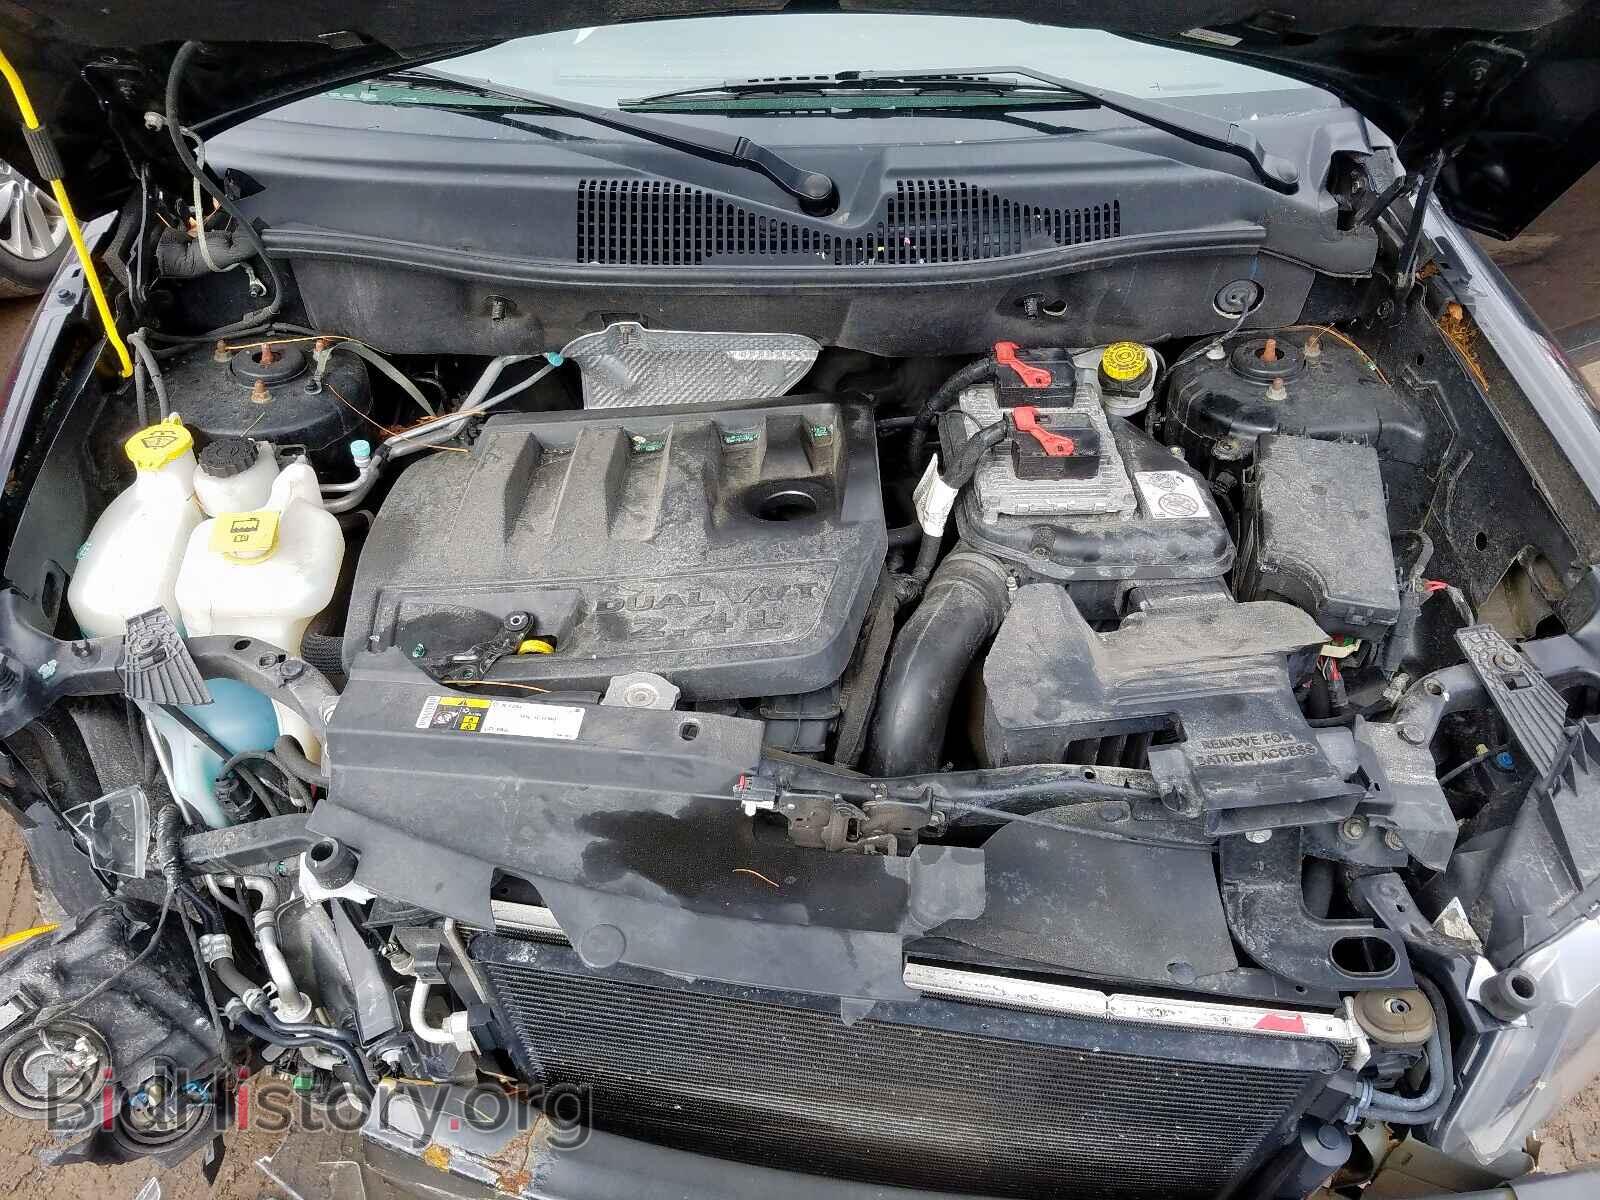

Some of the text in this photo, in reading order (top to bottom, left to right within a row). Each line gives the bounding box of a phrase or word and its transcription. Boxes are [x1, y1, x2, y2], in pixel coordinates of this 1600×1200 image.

[1201, 731, 1295, 750] REMOVE FOR
[1261, 743, 1317, 760] ACCESS
